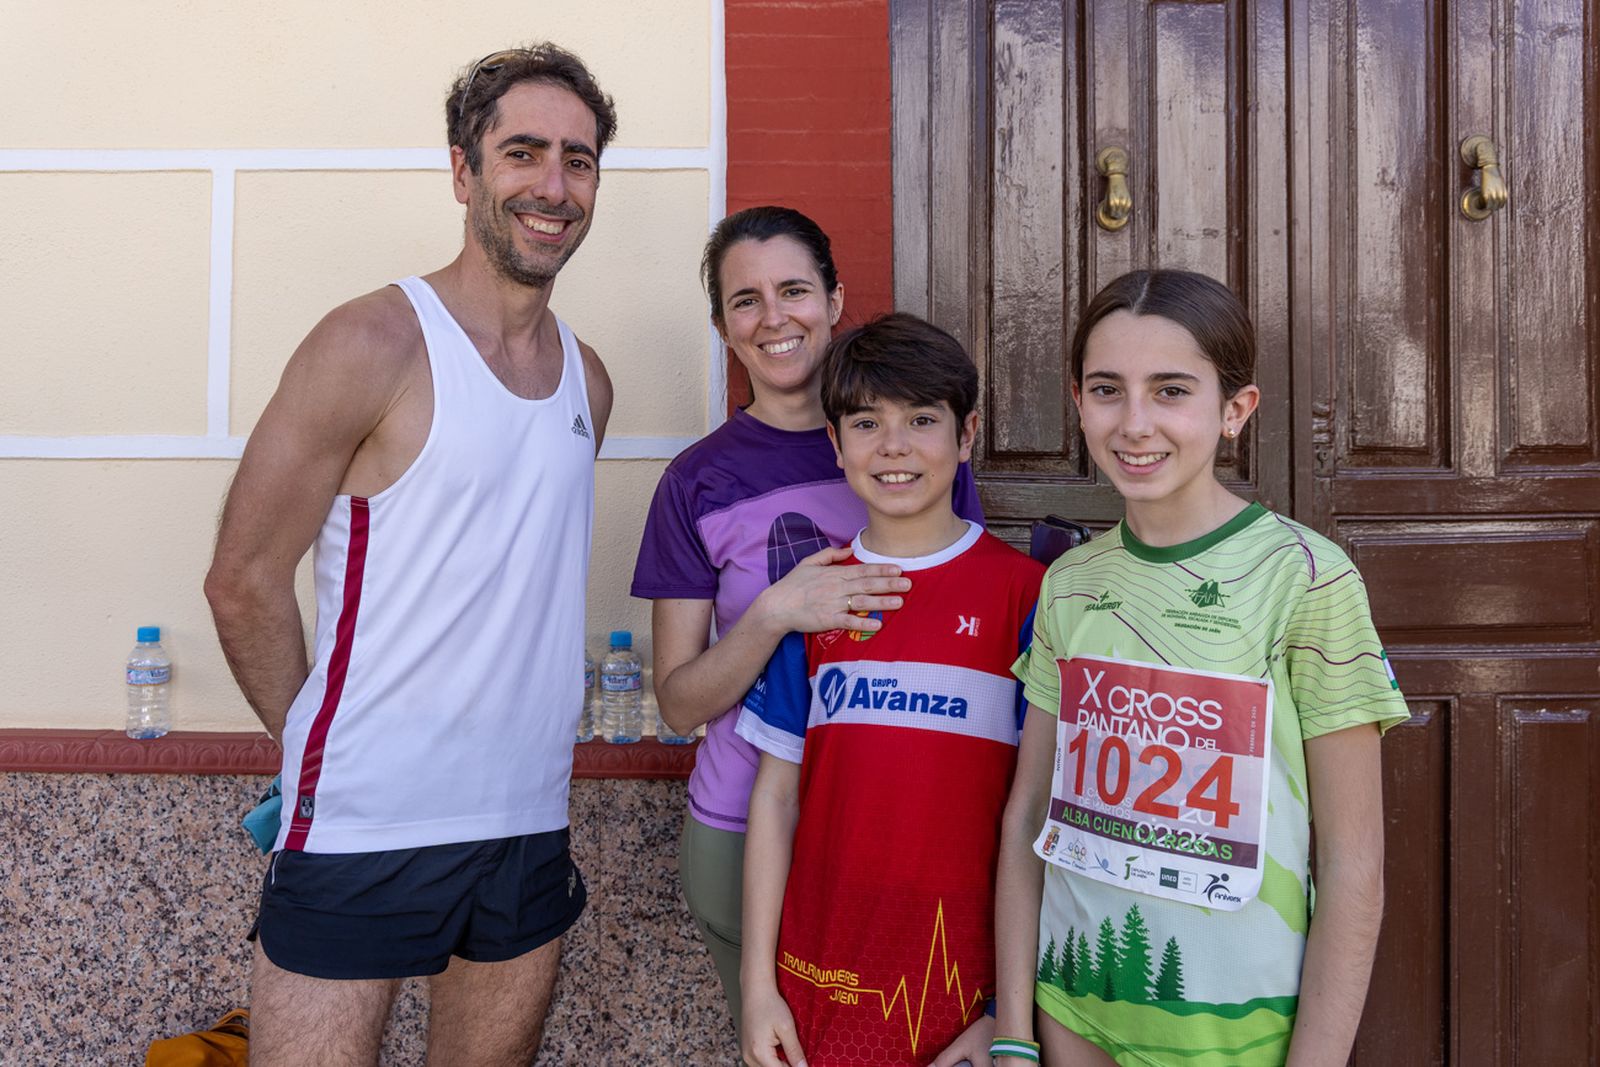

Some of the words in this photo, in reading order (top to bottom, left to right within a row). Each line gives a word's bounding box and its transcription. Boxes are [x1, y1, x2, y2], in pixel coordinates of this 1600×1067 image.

[848, 677, 968, 719] Avanza
[872, 678, 898, 688] GRUPO
[1079, 667, 1106, 708] X
[1108, 685, 1223, 730] CROSS
[1076, 708, 1190, 752] PANTANO
[1195, 736, 1221, 752] DEL
[1068, 728, 1240, 829] 1024
[1062, 806, 1090, 829] ALBA
[1093, 816, 1158, 846] CUENCA
[1164, 833, 1233, 861] ROSAS
